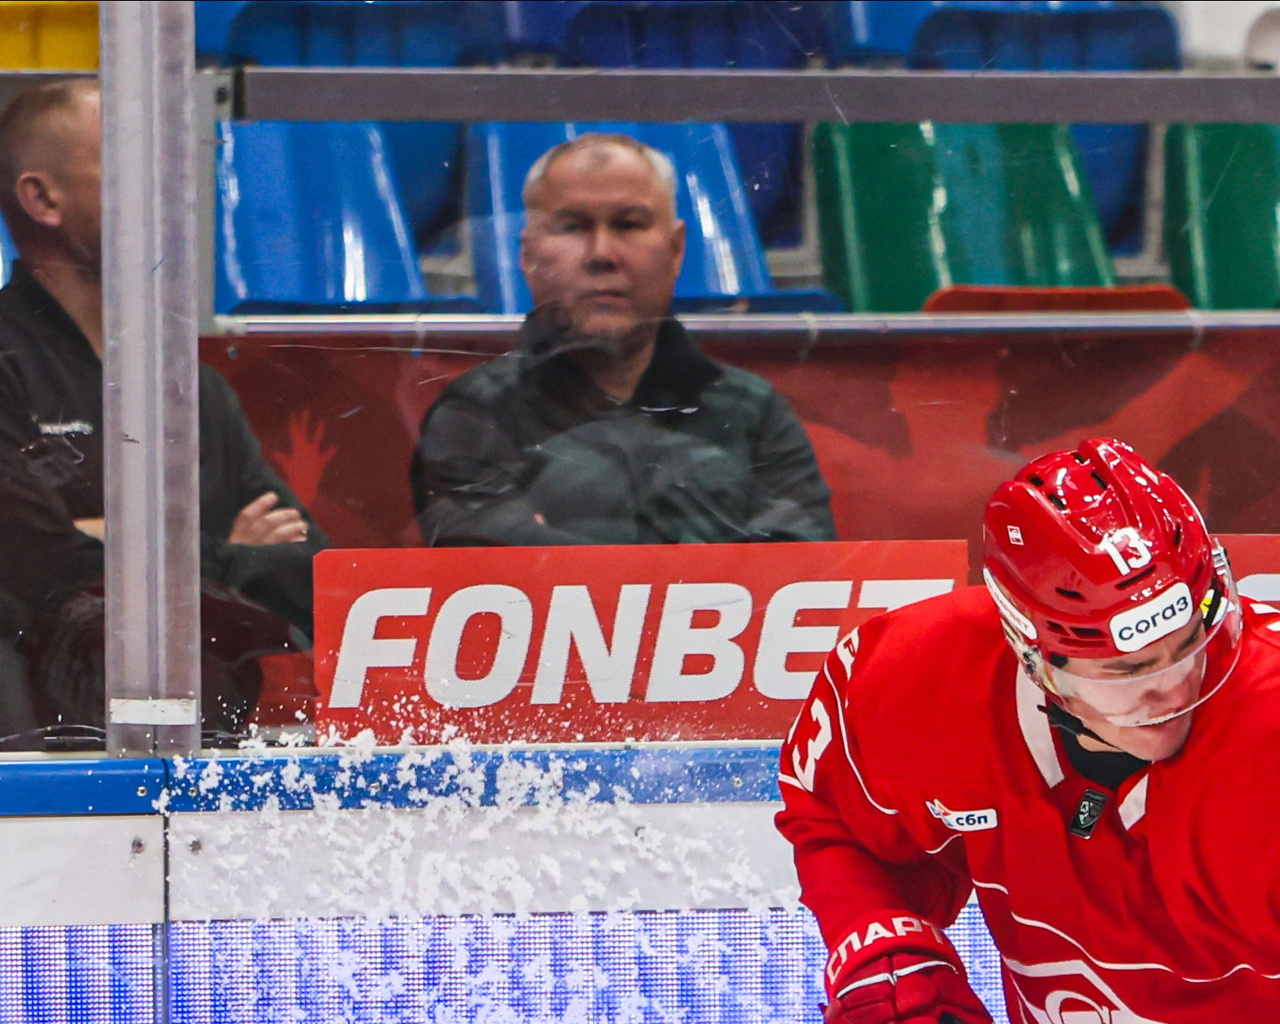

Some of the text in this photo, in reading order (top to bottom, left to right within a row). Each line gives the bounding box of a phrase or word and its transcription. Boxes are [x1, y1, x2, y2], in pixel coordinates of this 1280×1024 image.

[1099, 526, 1153, 576] 13
[1117, 595, 1190, 642] согаз
[955, 813, 989, 827] сбп
